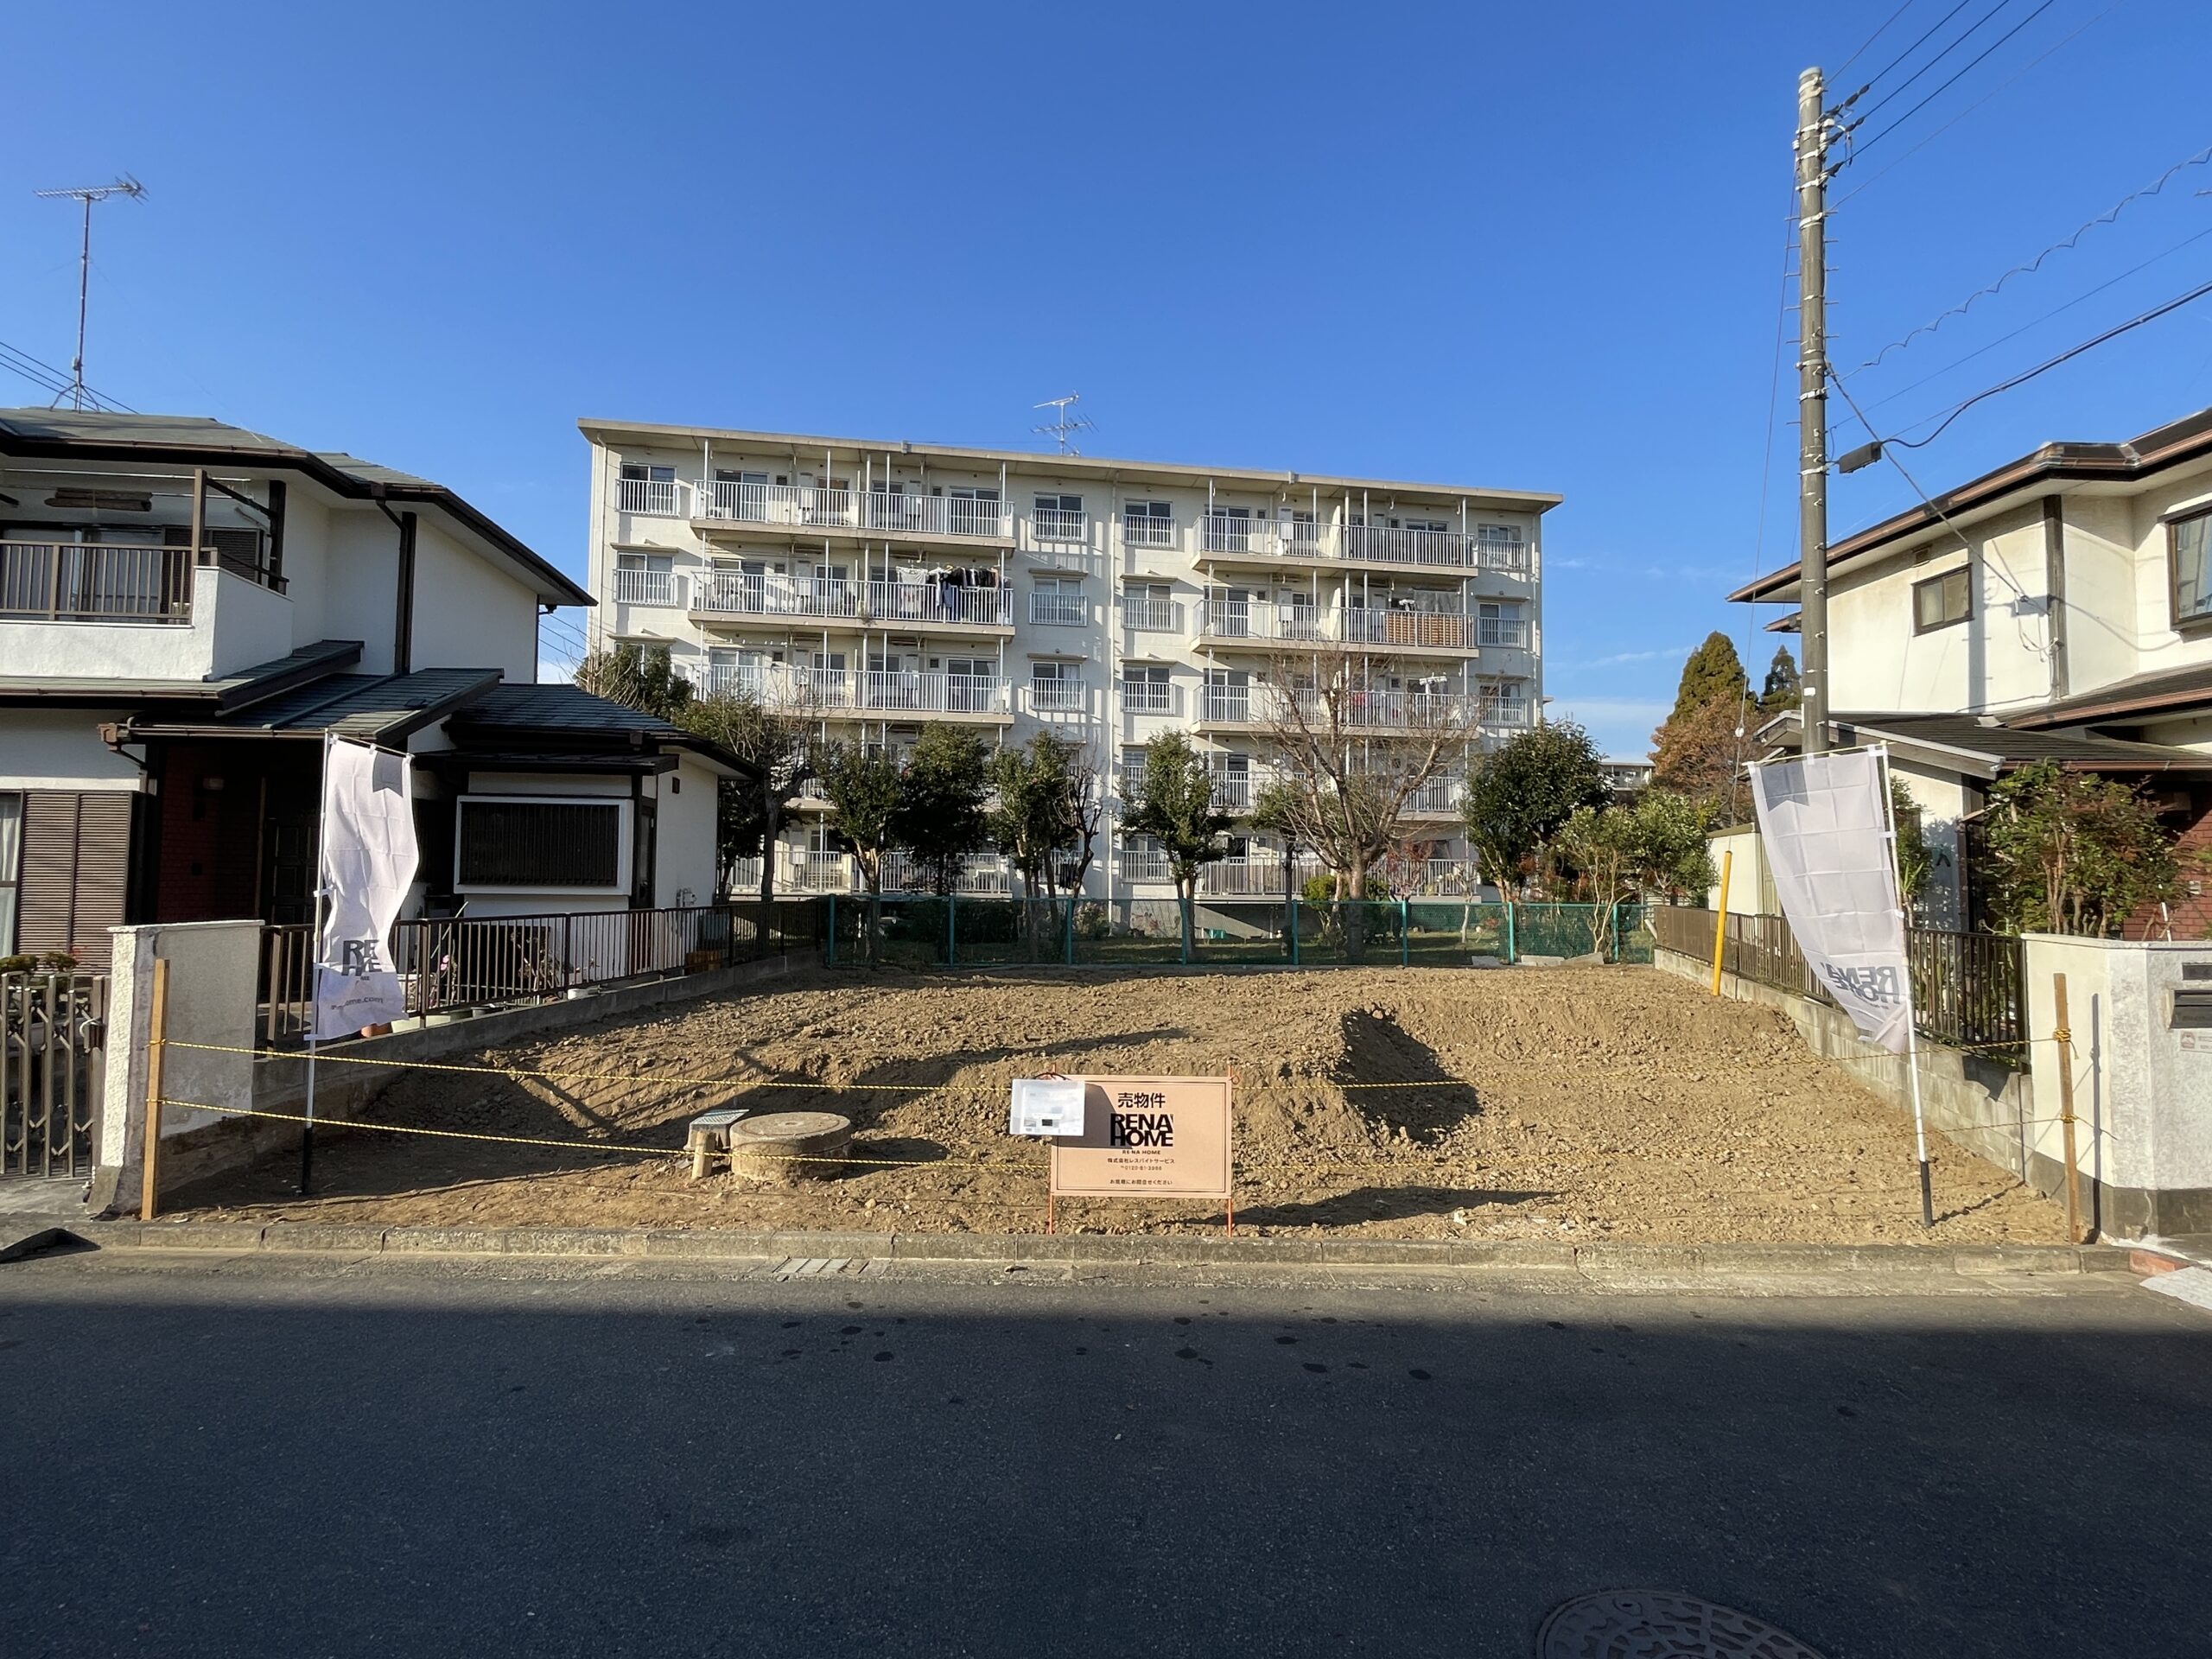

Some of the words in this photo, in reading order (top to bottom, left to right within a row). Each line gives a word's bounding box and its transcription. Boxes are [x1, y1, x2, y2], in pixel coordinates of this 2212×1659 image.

[1118, 1092, 1166, 1108] 売物件
[1110, 1129, 1173, 1147] HOME
